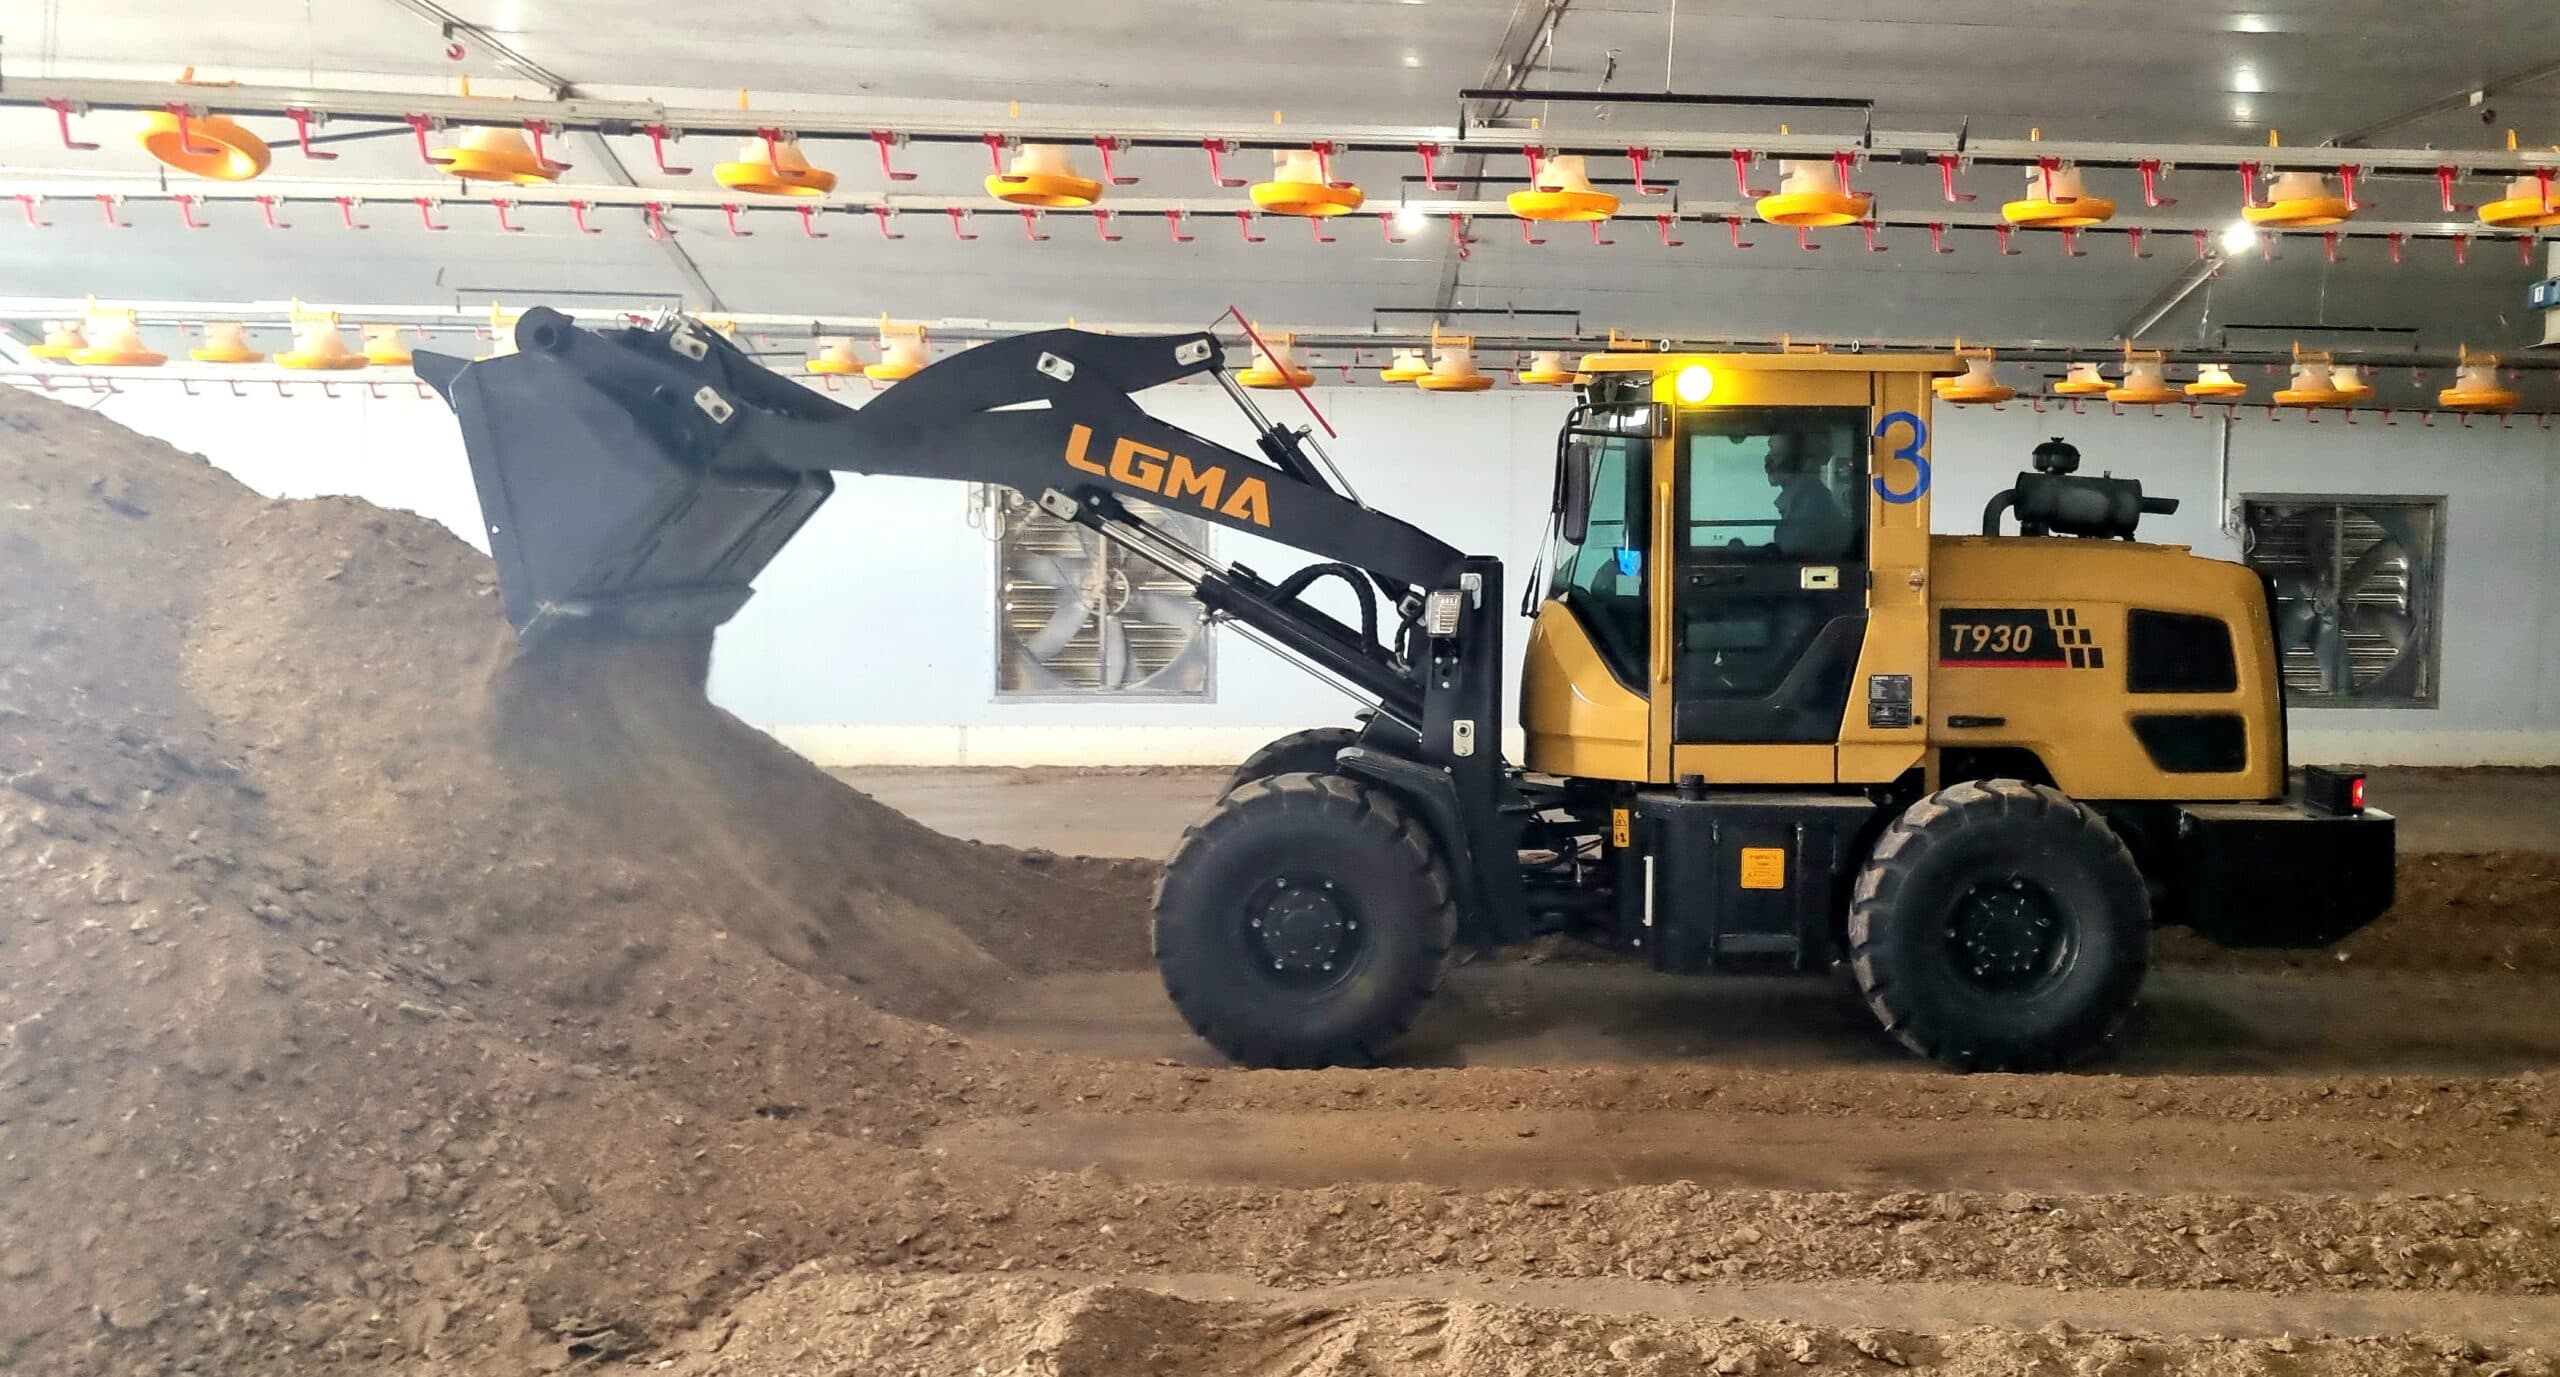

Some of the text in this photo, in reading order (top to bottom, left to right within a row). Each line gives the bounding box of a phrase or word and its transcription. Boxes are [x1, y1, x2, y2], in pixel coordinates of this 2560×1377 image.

[1065, 424, 1270, 527] LGMA
[1873, 411, 1930, 504] 3
[1950, 625, 2032, 652] T930
